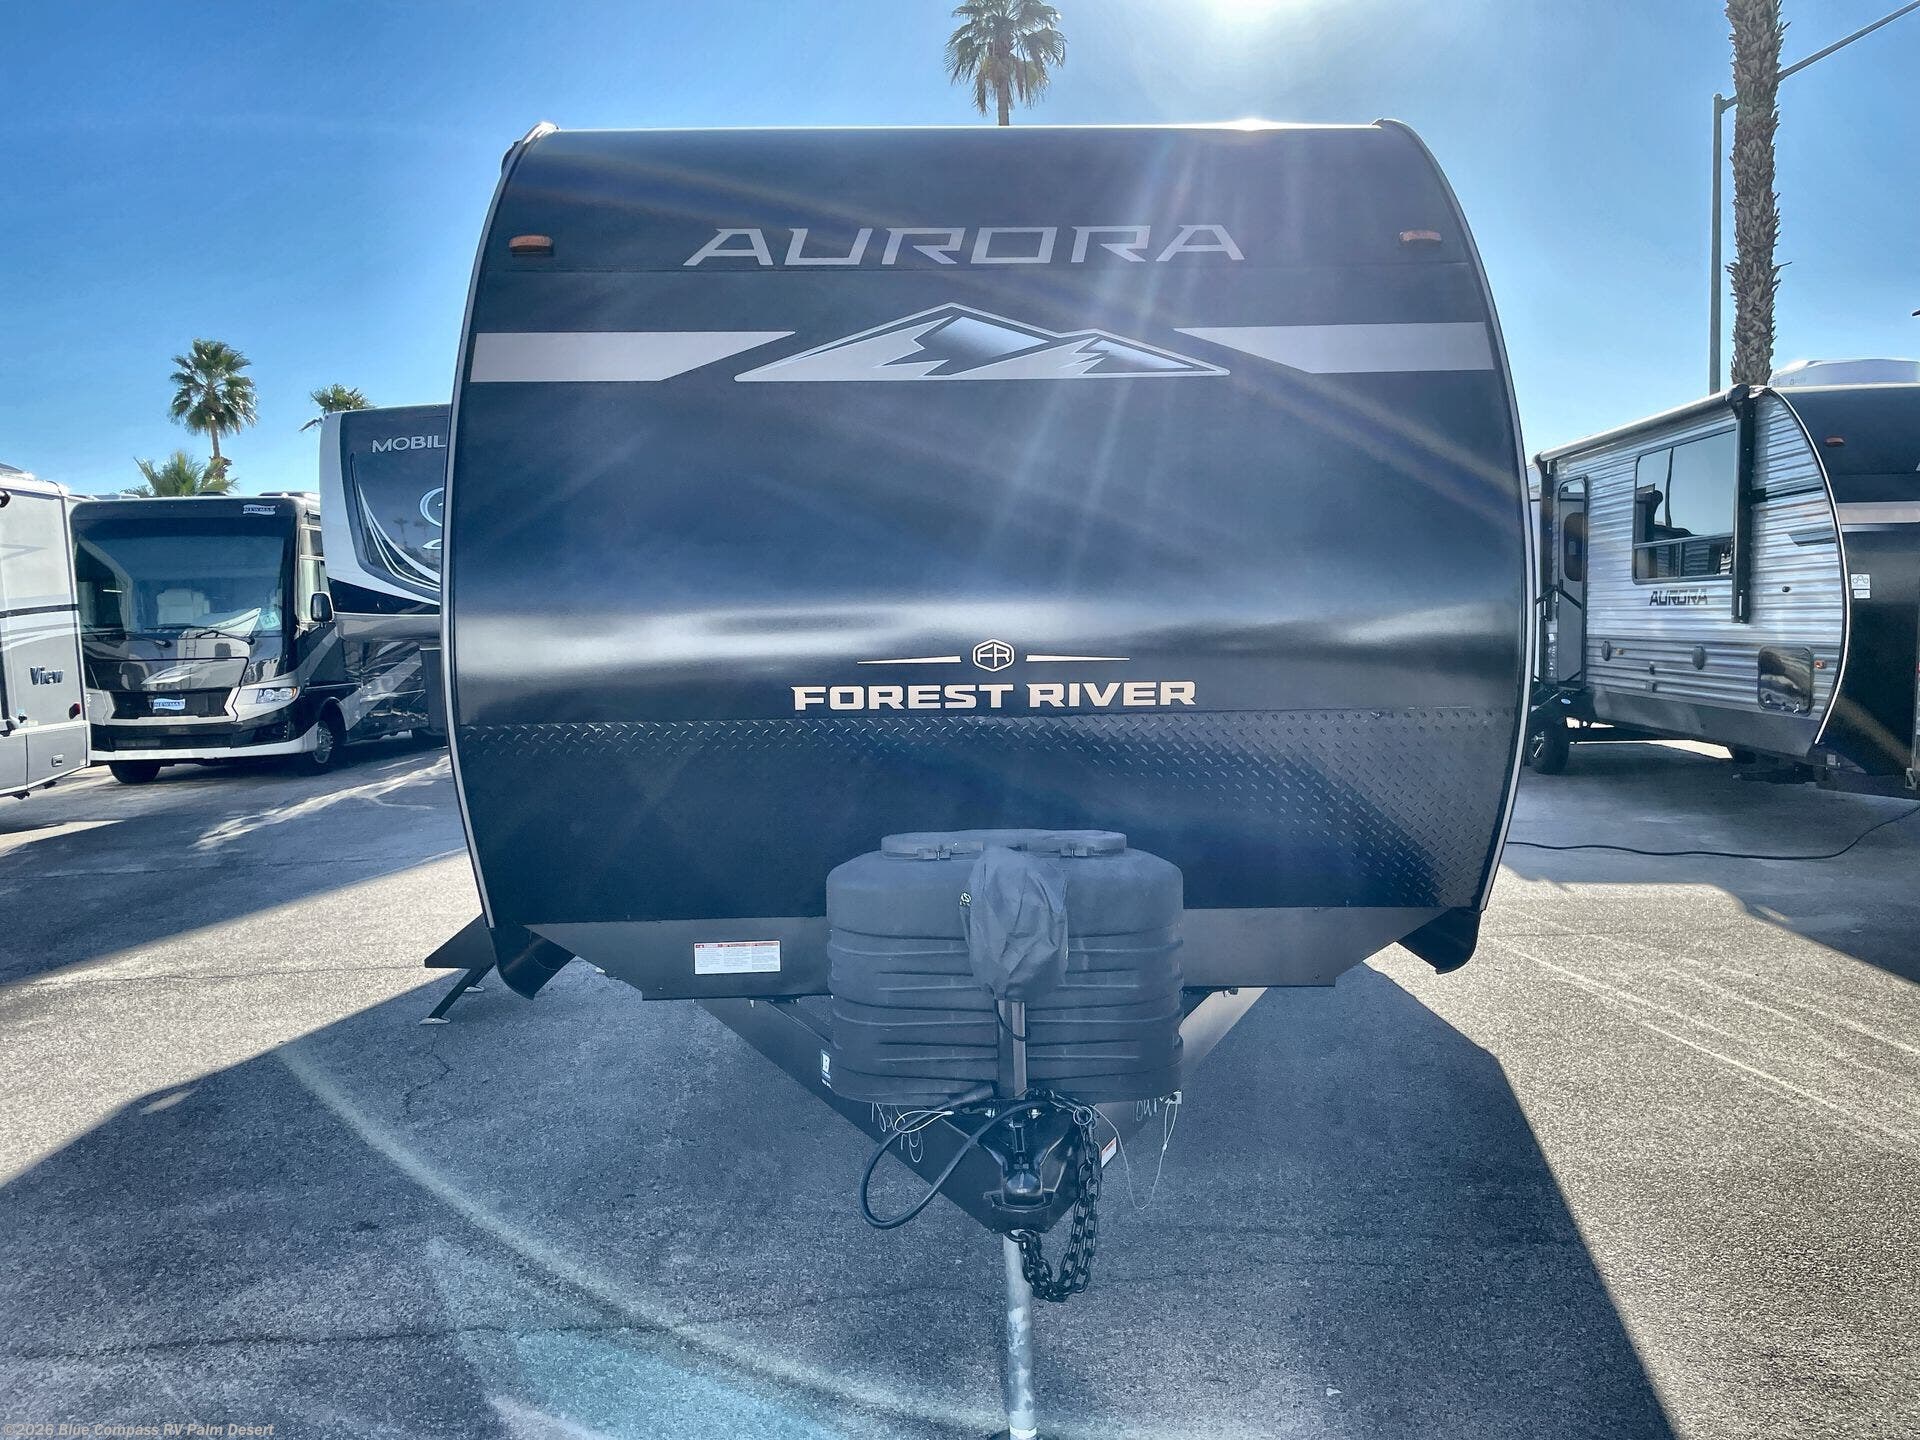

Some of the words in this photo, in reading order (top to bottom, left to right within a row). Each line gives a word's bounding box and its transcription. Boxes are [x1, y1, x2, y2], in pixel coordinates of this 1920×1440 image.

[683, 224, 1245, 267] AURORA
[1649, 589, 1708, 606] AURORA
[29, 667, 64, 686] View
[791, 684, 1014, 711] FOREST
[1026, 681, 1197, 708] RIVER
